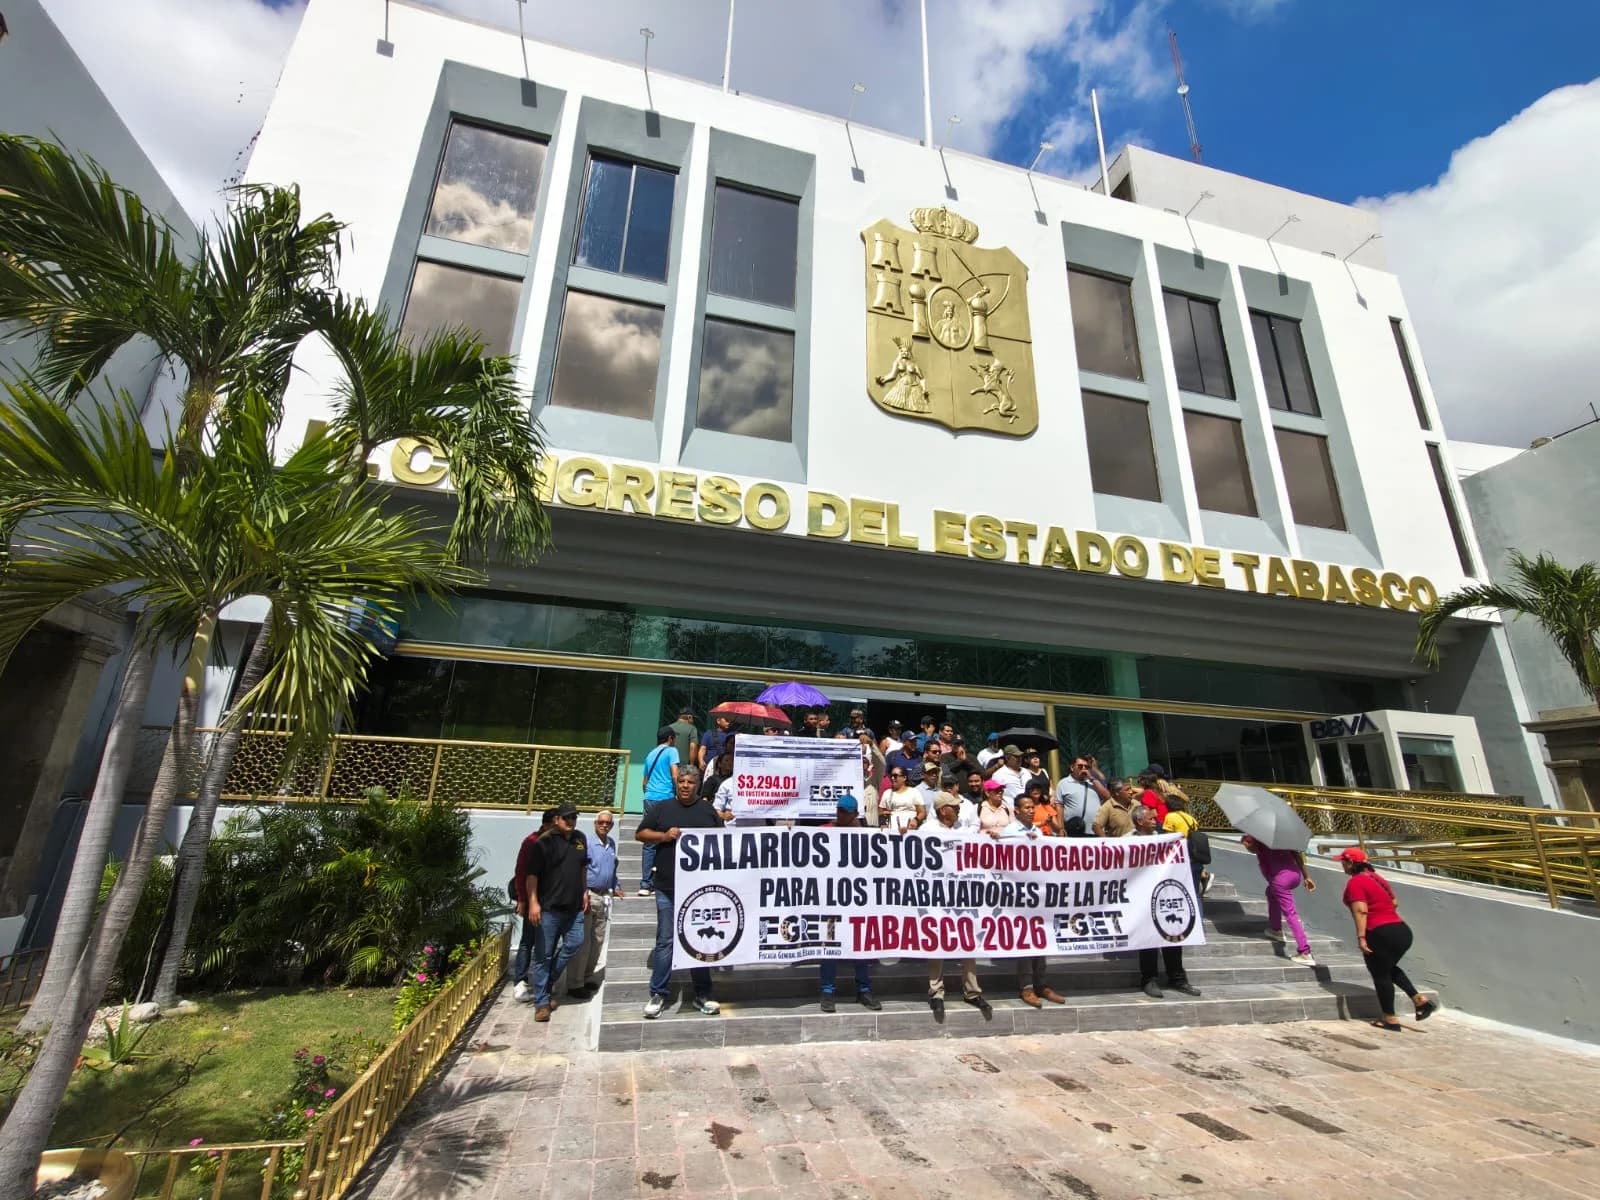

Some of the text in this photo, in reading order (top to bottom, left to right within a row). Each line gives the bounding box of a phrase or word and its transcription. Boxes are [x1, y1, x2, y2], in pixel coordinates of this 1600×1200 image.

[390, 435, 791, 531] CGRESO
[807, 491, 919, 551] DEL
[933, 509, 1150, 579] ESTADO
[1161, 542, 1226, 589] DE
[1234, 553, 1440, 612] TABASCO
[1310, 713, 1379, 739] BBVA
[809, 785, 854, 799] FGET
[680, 831, 831, 872] SALARIOS
[838, 833, 944, 870] JUSTOS
[956, 841, 1125, 873] ¡HOMOLOGACIÓN
[760, 877, 821, 908] PARA
[826, 877, 868, 907] LOS
[873, 878, 1040, 910] TRABAJADORES
[1045, 882, 1069, 908] DE
[1074, 882, 1096, 907] LA
[1099, 878, 1130, 905] FGE
[691, 907, 731, 921] FGET
[759, 911, 1123, 953] FGET TABASCO 2026 FGET
